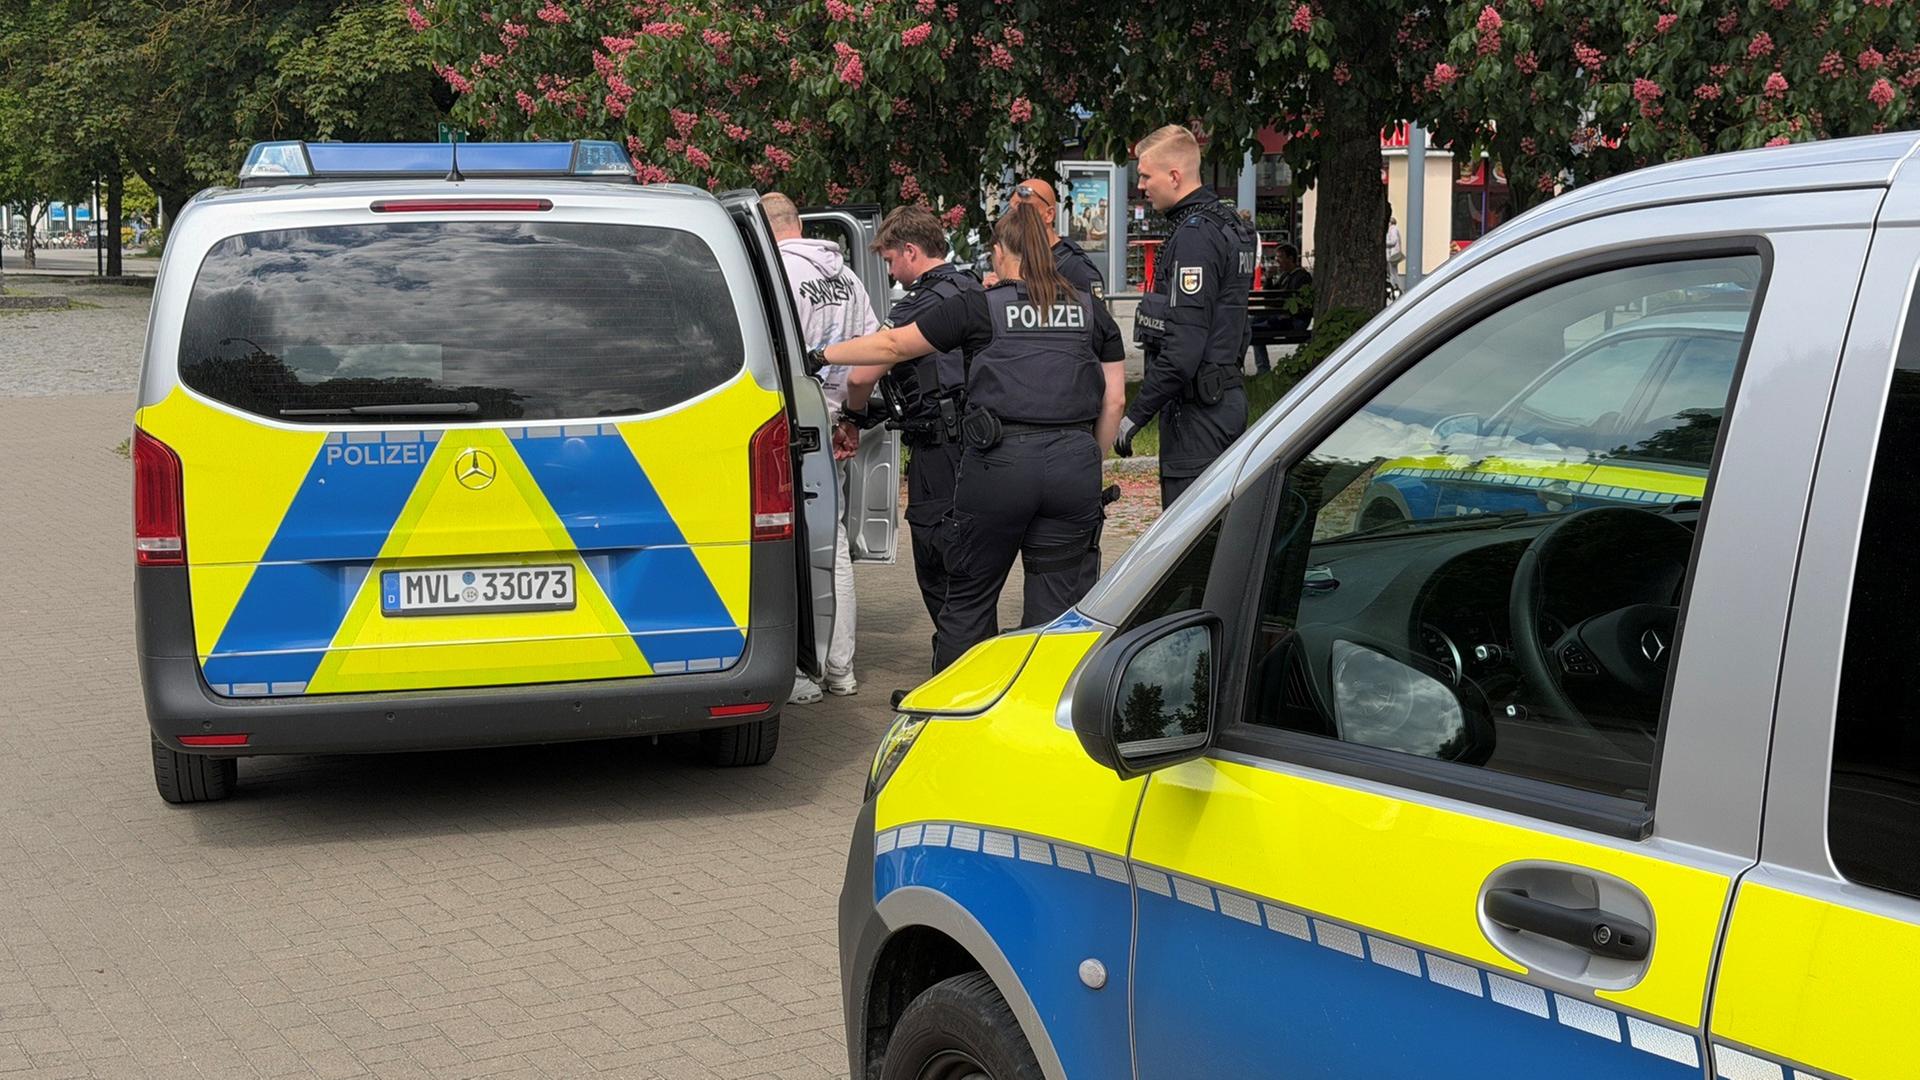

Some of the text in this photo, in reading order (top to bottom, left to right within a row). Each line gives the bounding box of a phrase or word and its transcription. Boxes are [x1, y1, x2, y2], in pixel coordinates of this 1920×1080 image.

[1006, 304, 1084, 328] POLIZEI
[327, 444, 425, 466] POLIZEI
[388, 595, 396, 603] D
[406, 570, 568, 605] MVL 33073
